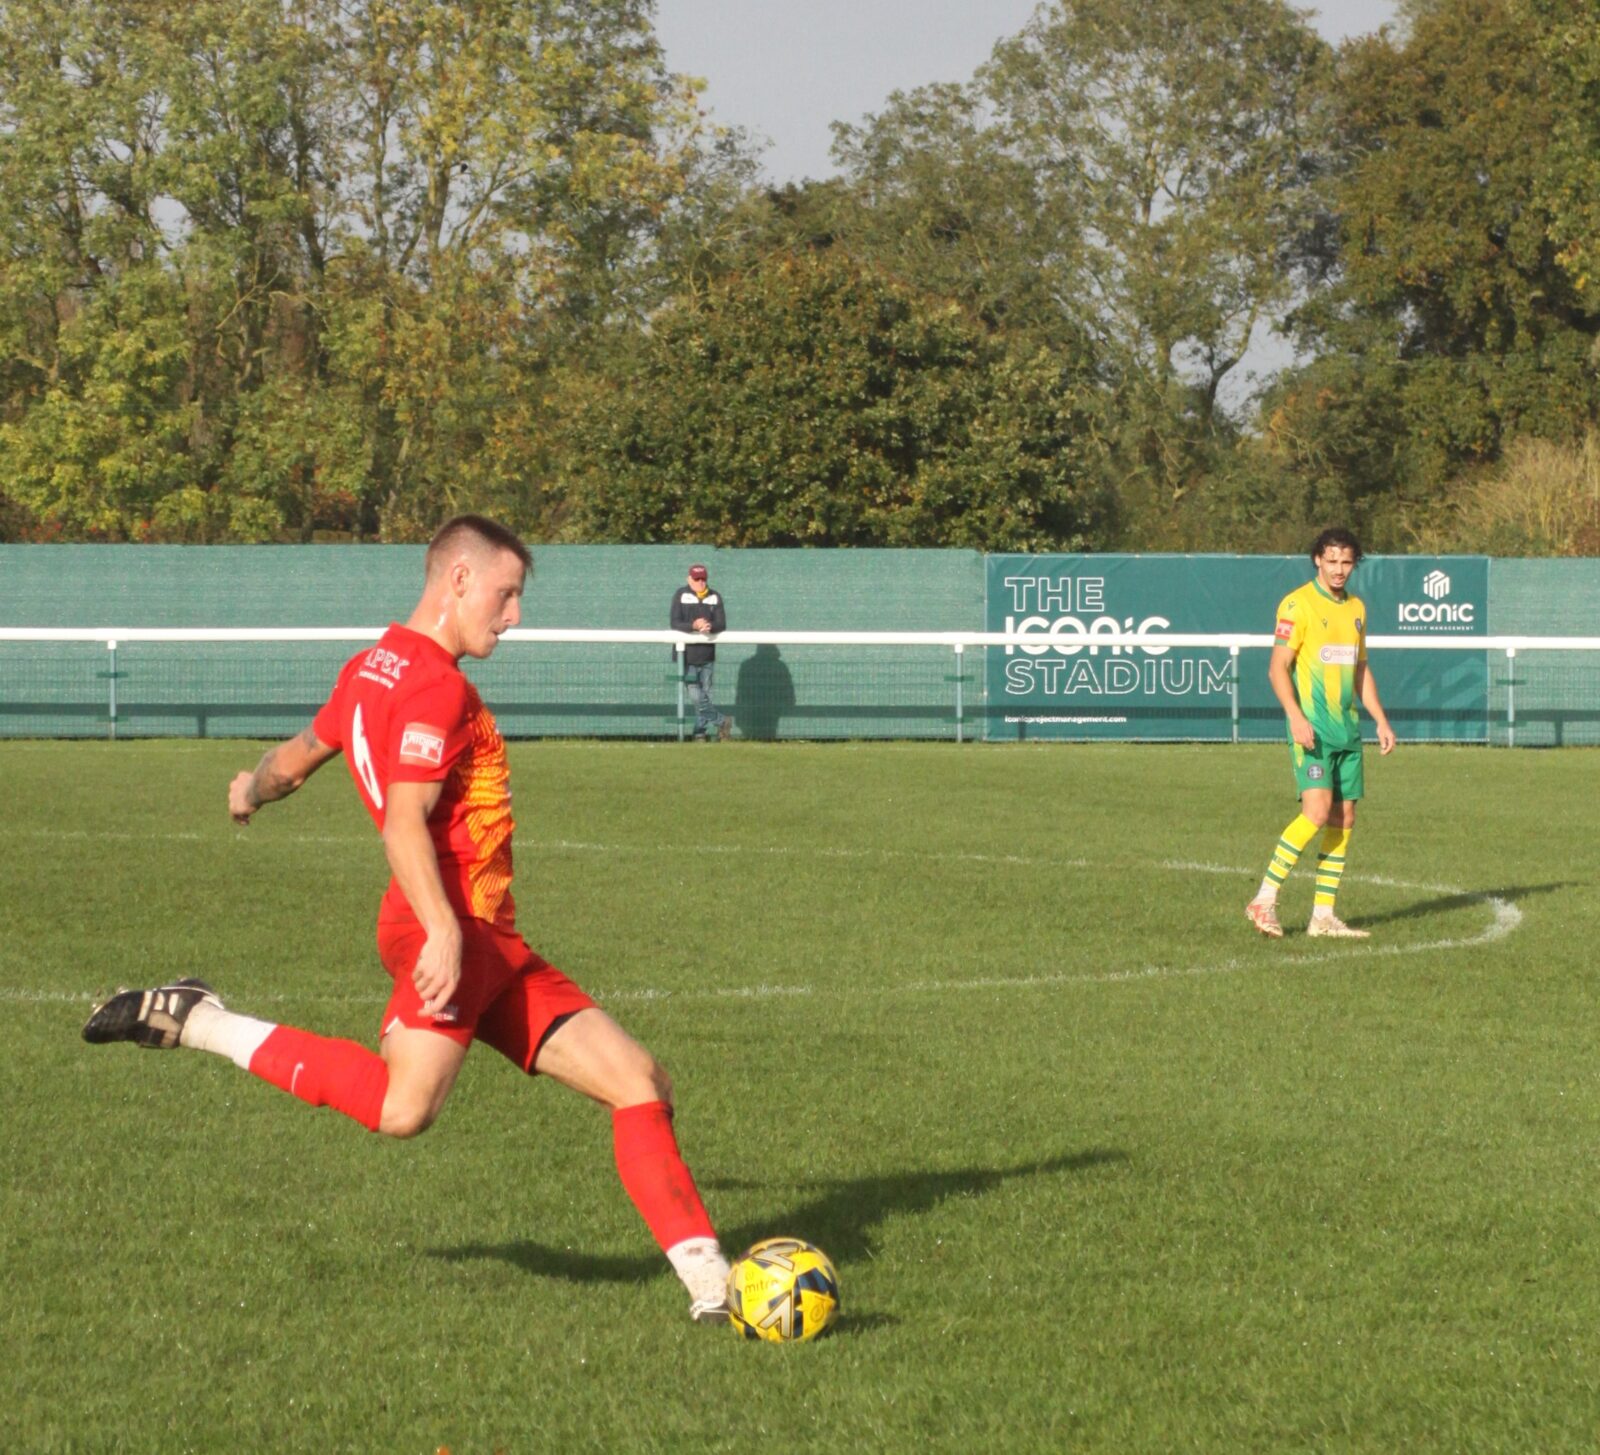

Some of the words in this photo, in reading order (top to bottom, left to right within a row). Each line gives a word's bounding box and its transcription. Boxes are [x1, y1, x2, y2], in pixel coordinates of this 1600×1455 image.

[1004, 576, 1105, 613] THE
[1004, 658, 1234, 695] STADIUM
[1004, 714, 1127, 725] iconicprojectmanagement.com
